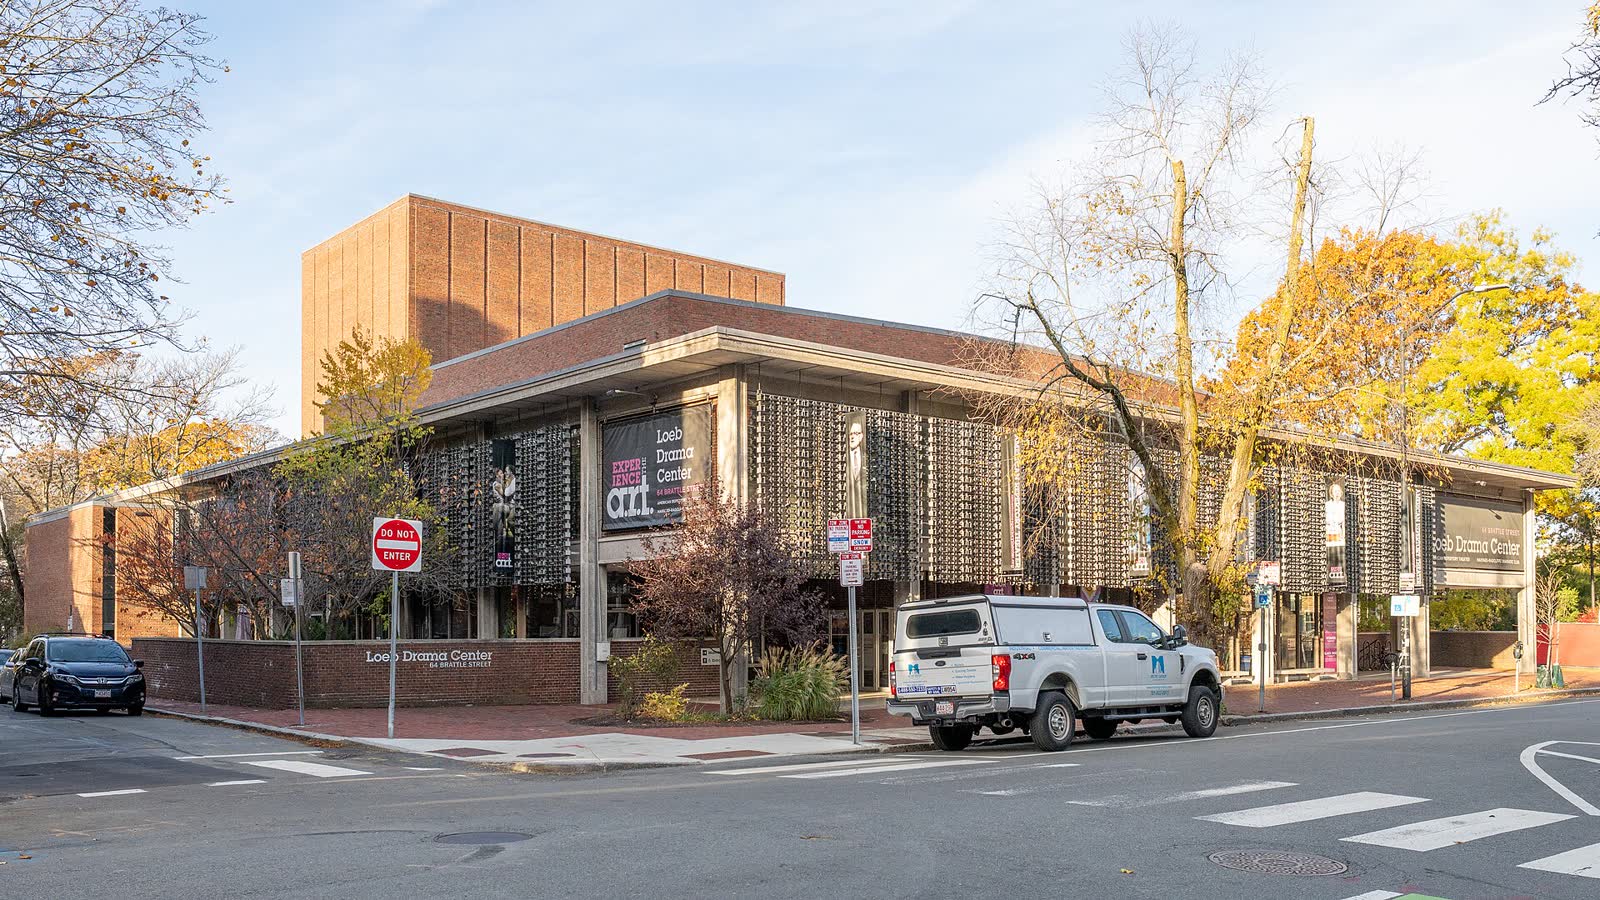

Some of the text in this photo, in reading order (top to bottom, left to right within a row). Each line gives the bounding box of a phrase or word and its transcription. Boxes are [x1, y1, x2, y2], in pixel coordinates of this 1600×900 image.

[657, 427, 682, 443] Loeb
[657, 447, 694, 463] Drama
[612, 458, 640, 474] EXPER
[612, 472, 640, 487] IENCE
[657, 466, 692, 483] Center
[664, 486, 686, 495] BRATTLE
[381, 528, 415, 539] DO NOT
[1455, 535, 1489, 554] Drama
[1490, 538, 1521, 556] Center
[383, 551, 411, 561] ENTER
[402, 651, 448, 662] Drama
[450, 650, 493, 661] Center
